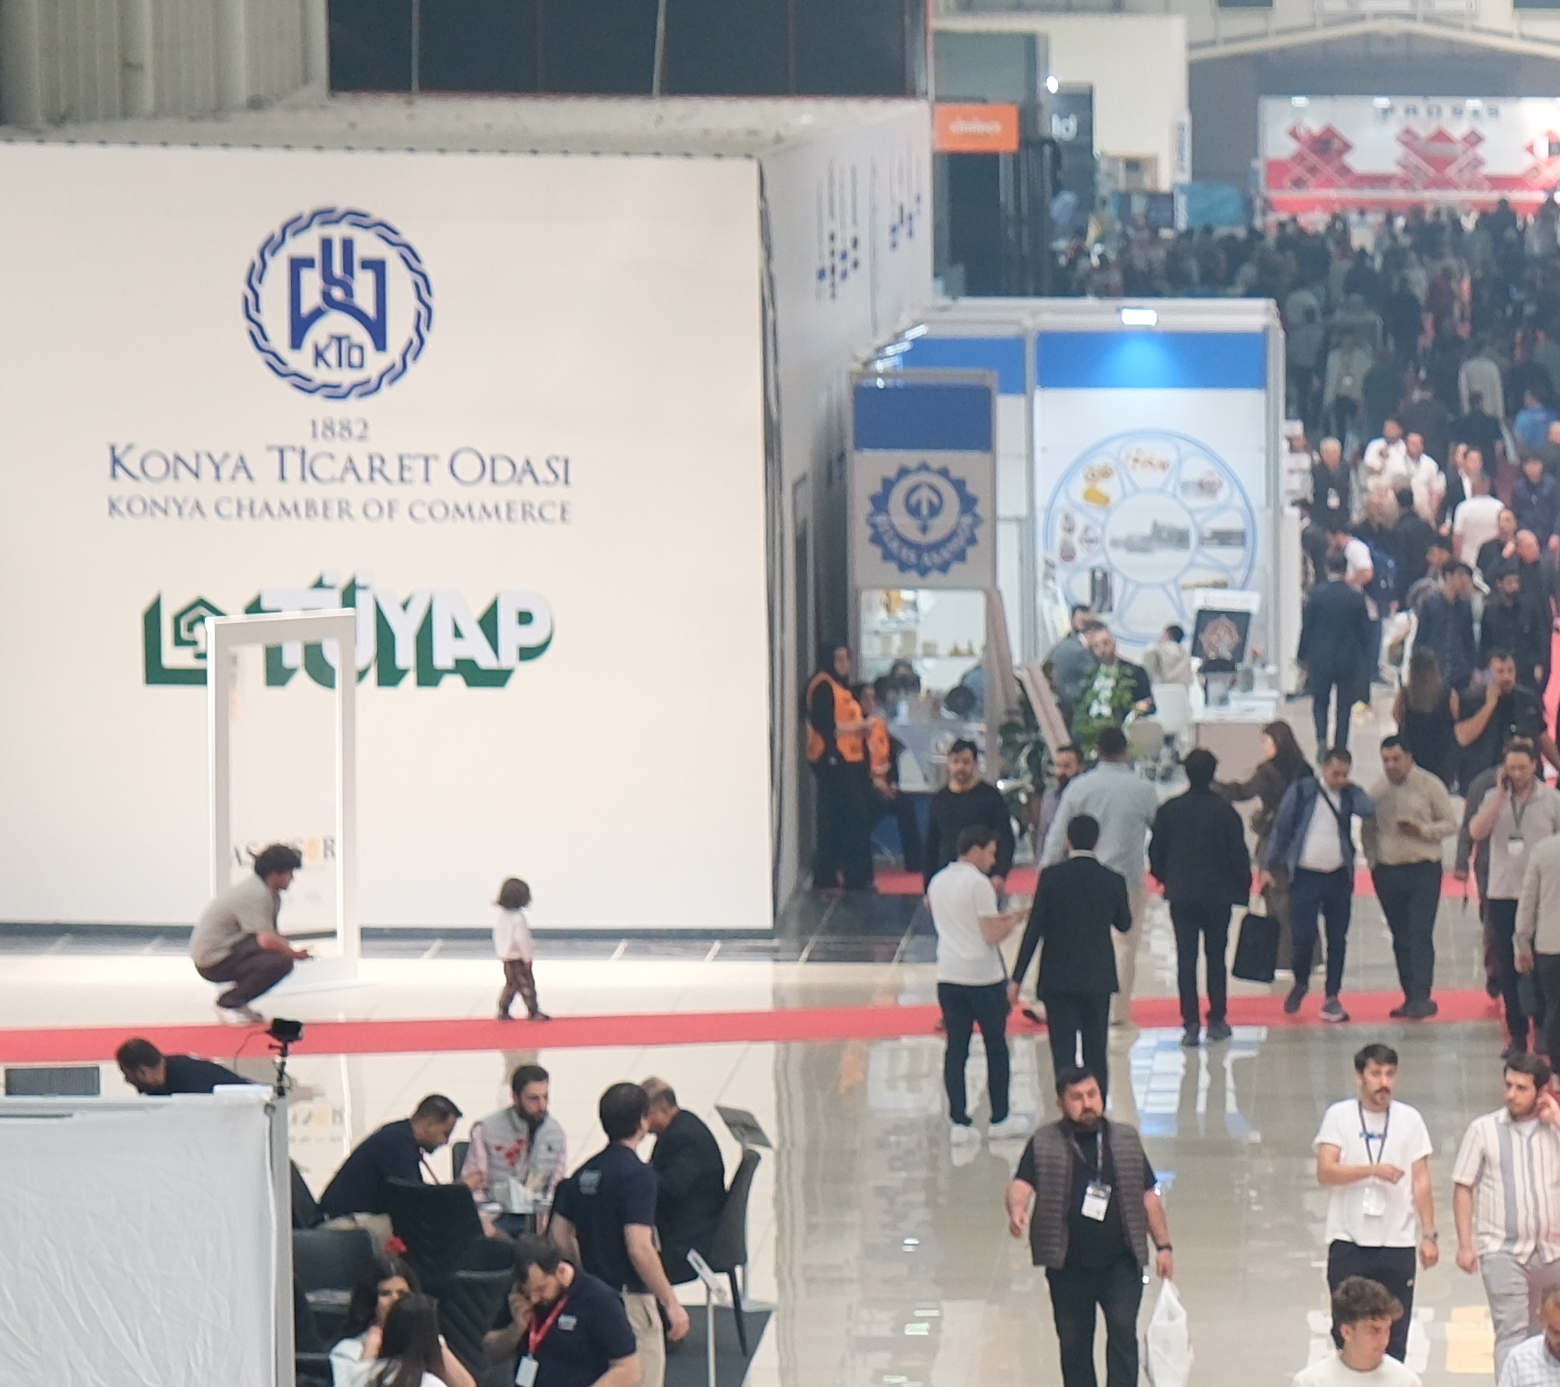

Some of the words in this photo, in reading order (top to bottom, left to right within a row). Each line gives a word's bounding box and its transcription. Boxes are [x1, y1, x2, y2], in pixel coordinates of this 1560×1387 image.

[313, 333, 365, 369] KTO
[310, 418, 370, 441] 1882
[108, 442, 255, 484] KONYA
[449, 447, 572, 487] ODASI
[107, 495, 206, 521] KONYA
[214, 497, 354, 522] CHAMBER
[362, 499, 400, 521] OF
[408, 499, 572, 524] COMMERCE
